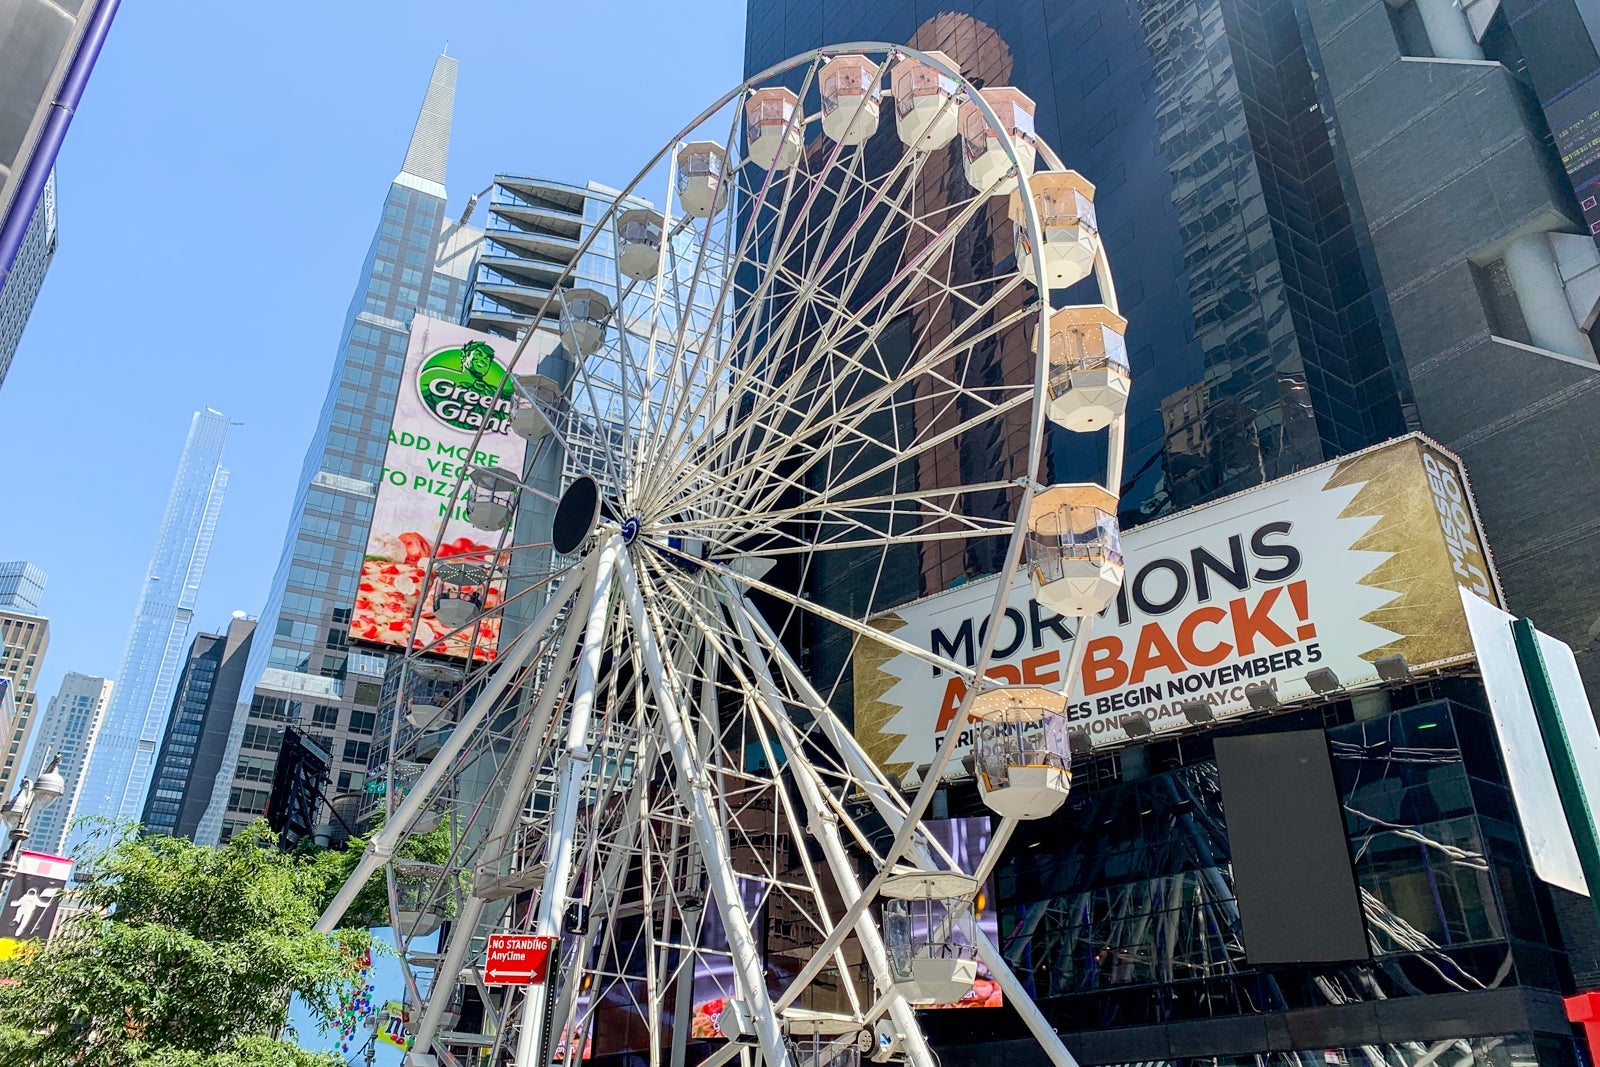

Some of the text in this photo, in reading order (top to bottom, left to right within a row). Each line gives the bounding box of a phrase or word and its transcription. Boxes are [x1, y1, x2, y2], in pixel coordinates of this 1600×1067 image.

[428, 377, 511, 413] Green
[436, 400, 511, 435] Giant
[1423, 452, 1469, 578] MISSED
[1437, 460, 1479, 554] TOO!
[1082, 579, 1318, 696] BACK!
[1096, 683, 1162, 715] BEGIN
[1167, 648, 1303, 698] NOVEMBER
[1306, 643, 1323, 664] 5
[491, 950, 526, 962] Anytime
[492, 939, 548, 951] NO STANDING
